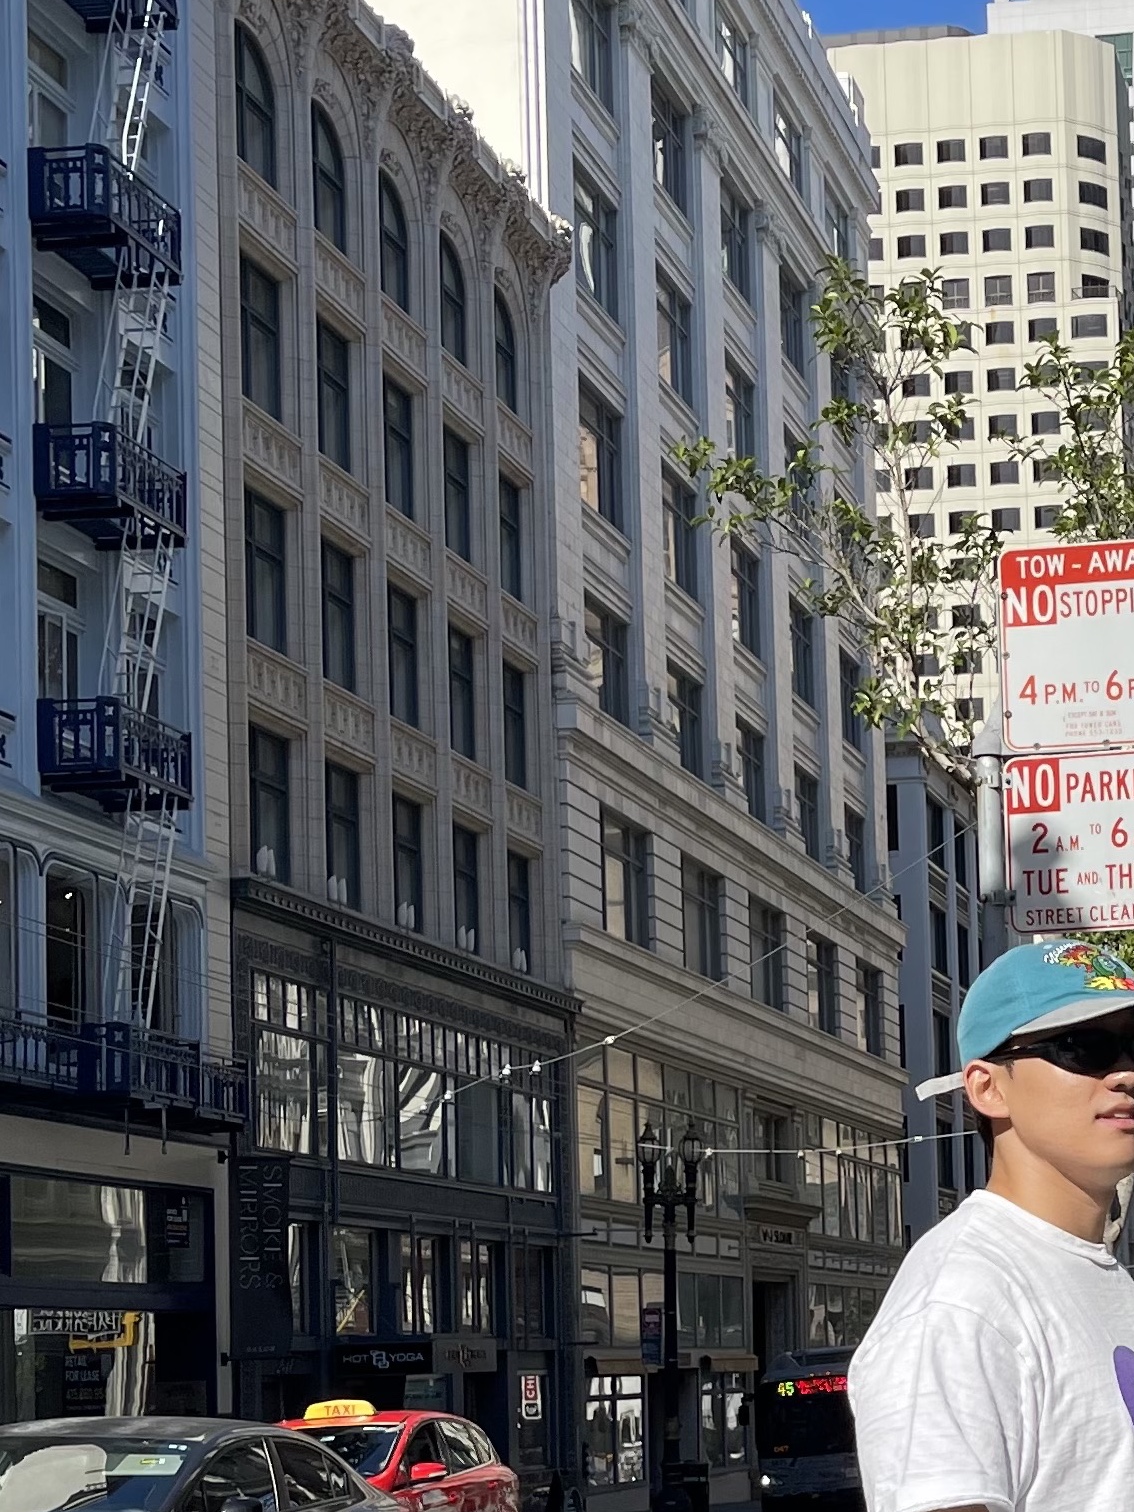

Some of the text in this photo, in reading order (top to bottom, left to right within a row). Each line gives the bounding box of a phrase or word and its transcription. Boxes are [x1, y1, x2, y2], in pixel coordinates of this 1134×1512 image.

[1006, 585, 1054, 625] NO
[1084, 681, 1100, 693] TO
[1011, 763, 1055, 808] NO
[1089, 823, 1101, 835] TO
[1022, 868, 1069, 896] TUE
[1076, 871, 1098, 885] AND
[1026, 906, 1084, 926] STREET
[343, 1354, 369, 1363] HOT
[389, 1352, 424, 1362] YOGA
[777, 1381, 795, 1396] 45
[324, 1404, 356, 1416] TAXI
